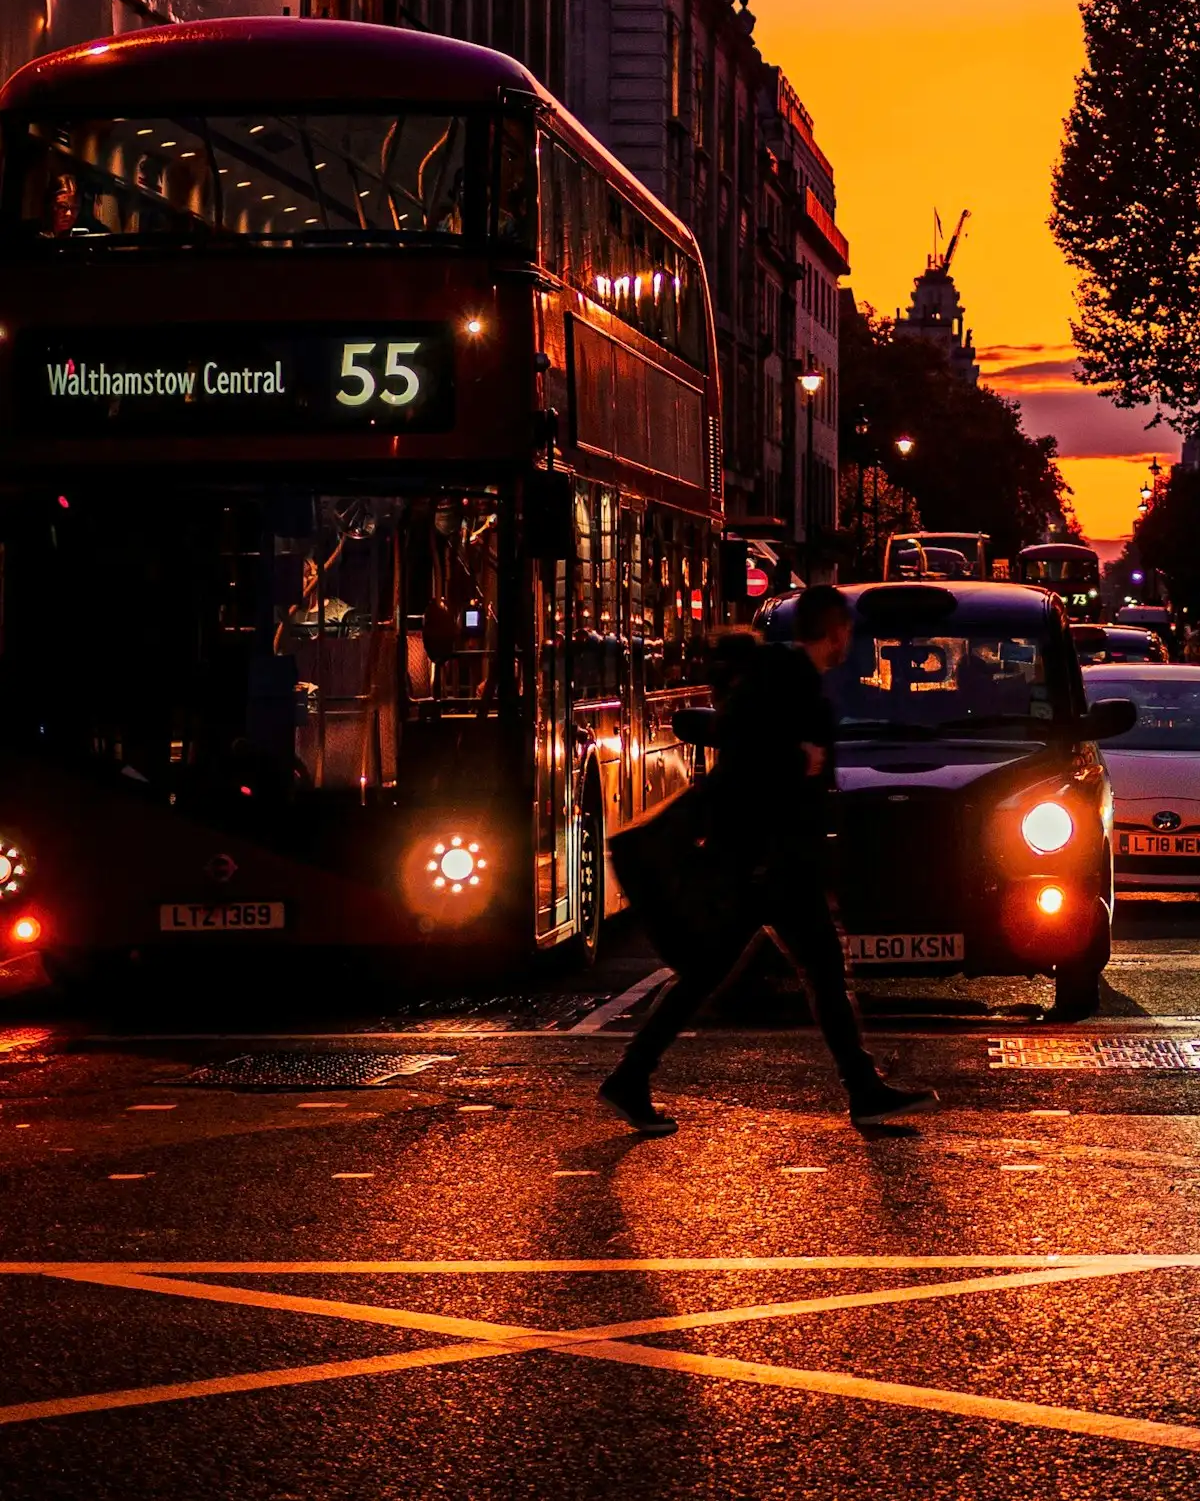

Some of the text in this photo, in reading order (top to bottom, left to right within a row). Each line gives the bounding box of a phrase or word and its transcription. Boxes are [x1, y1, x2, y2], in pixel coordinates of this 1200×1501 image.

[47, 361, 285, 396] Walthamstow Central
[335, 342, 421, 406] 55
[1072, 594, 1087, 606] 73
[1134, 837, 1170, 852] LT18
[911, 936, 955, 958] KSN
